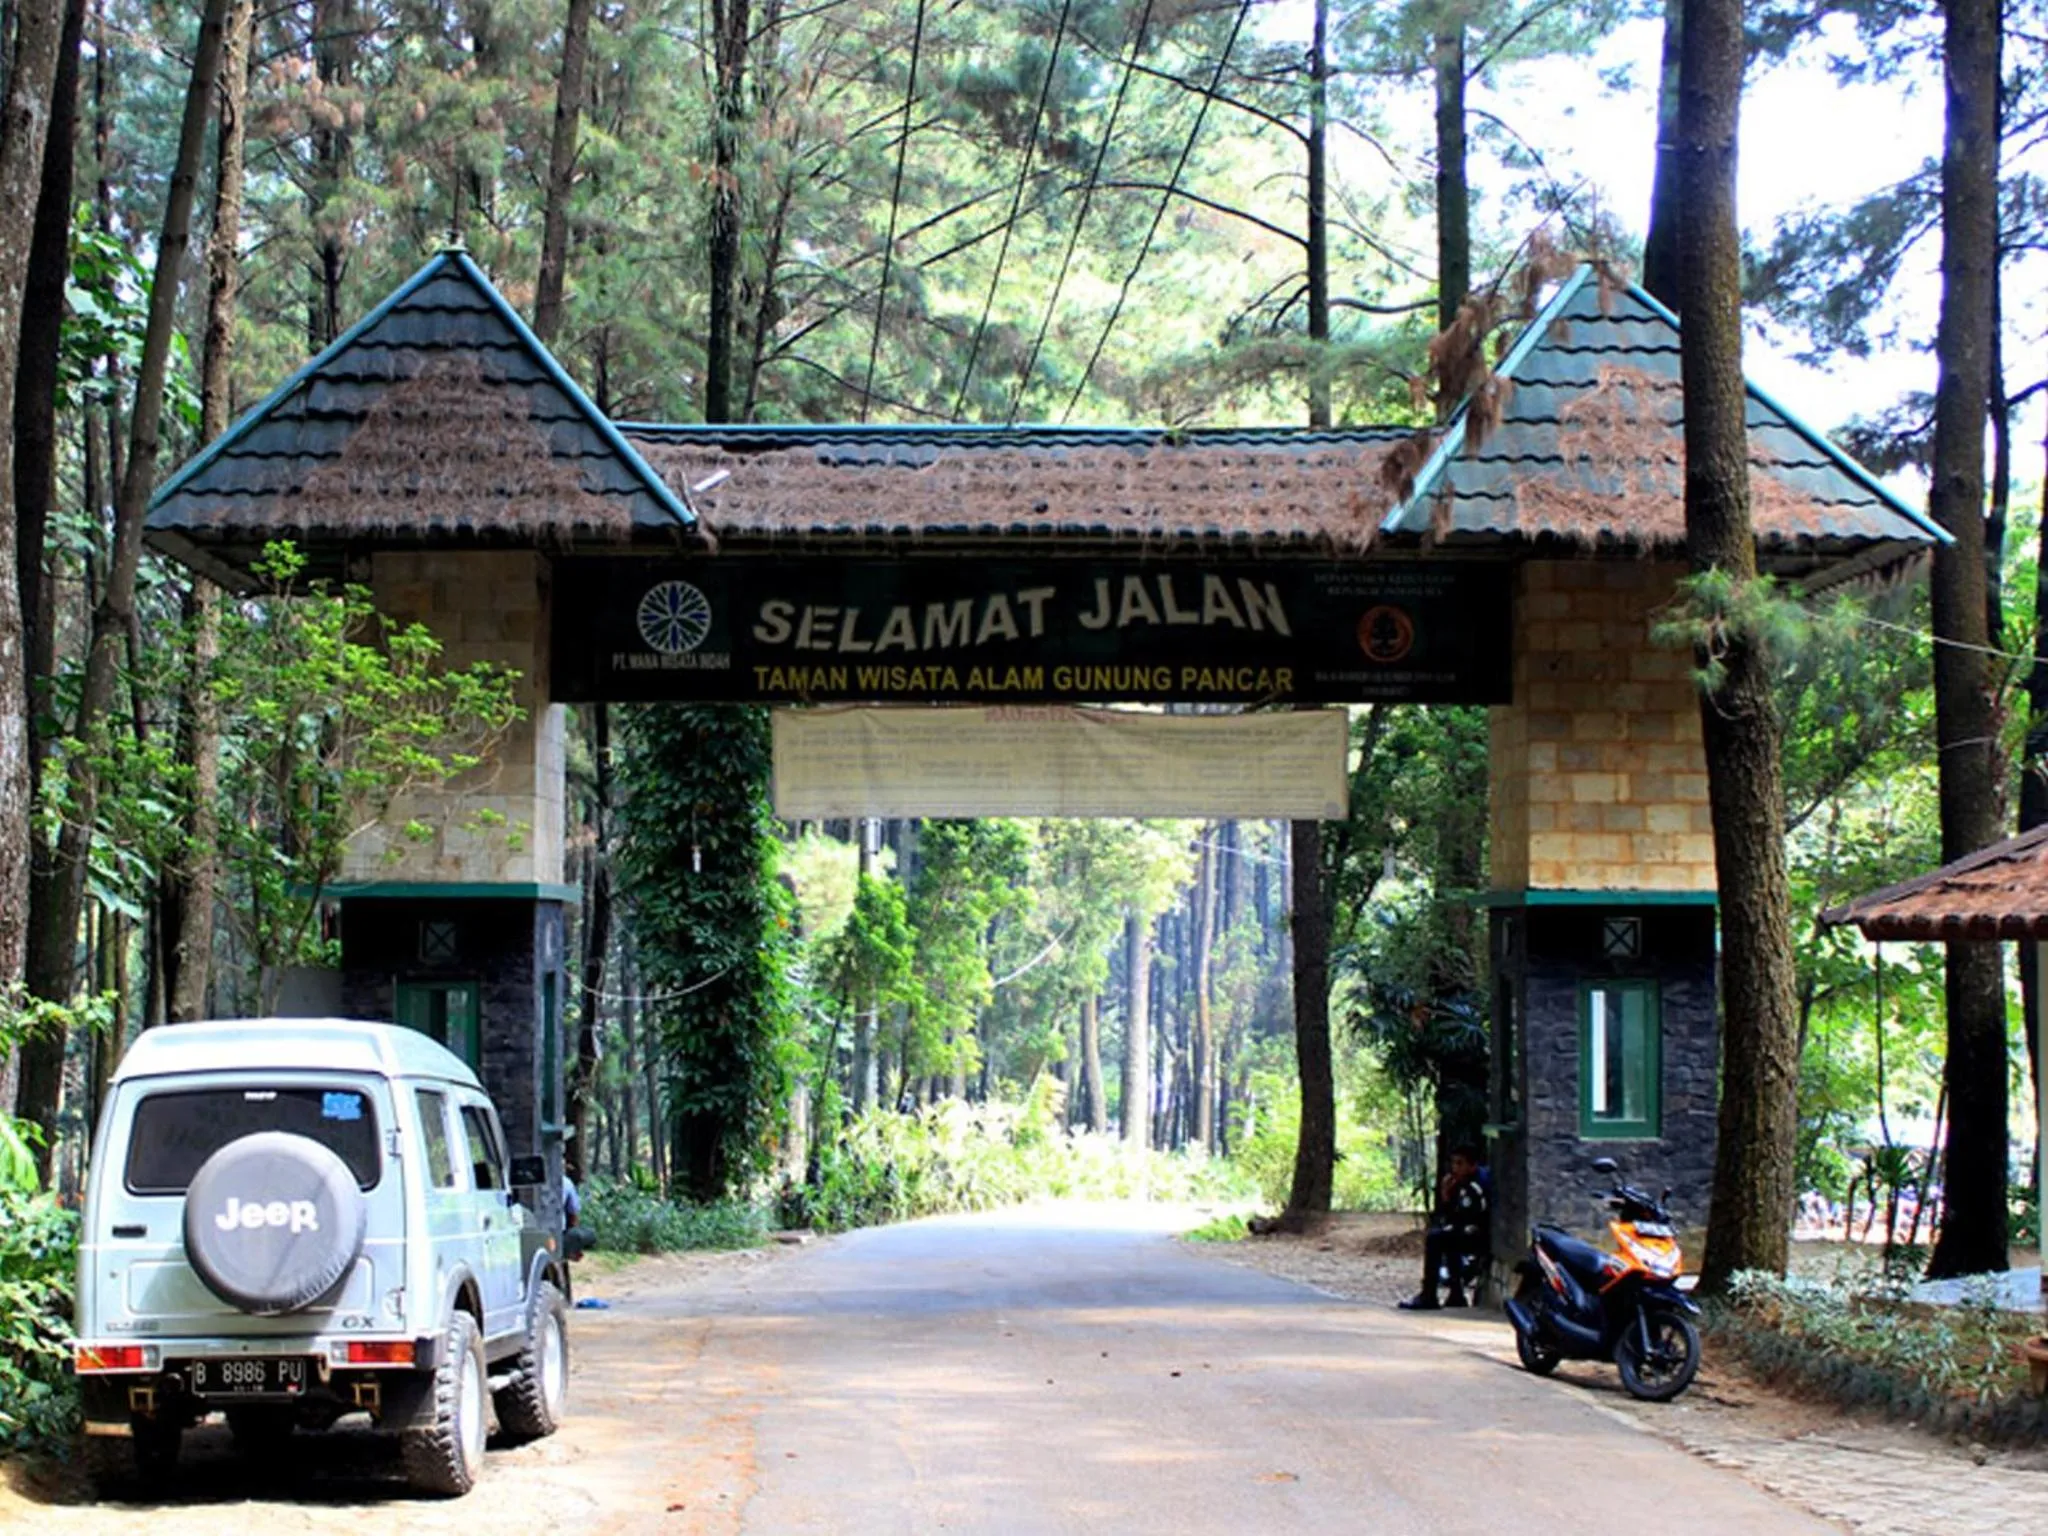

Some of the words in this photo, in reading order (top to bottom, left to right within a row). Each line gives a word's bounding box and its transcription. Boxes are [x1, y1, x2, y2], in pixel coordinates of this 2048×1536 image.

[752, 586, 1056, 653] SELAMAT
[1078, 574, 1292, 637] JALAN
[752, 666, 847, 691] TAMAN
[856, 666, 960, 691] WISATA
[967, 666, 1044, 691] ALAM
[1052, 666, 1173, 692] GUNUNG
[1180, 666, 1294, 692] PANCAR
[215, 1197, 318, 1233] Jeep
[195, 1361, 207, 1385] B
[222, 1360, 267, 1384] 8986
[278, 1359, 302, 1383] PU
